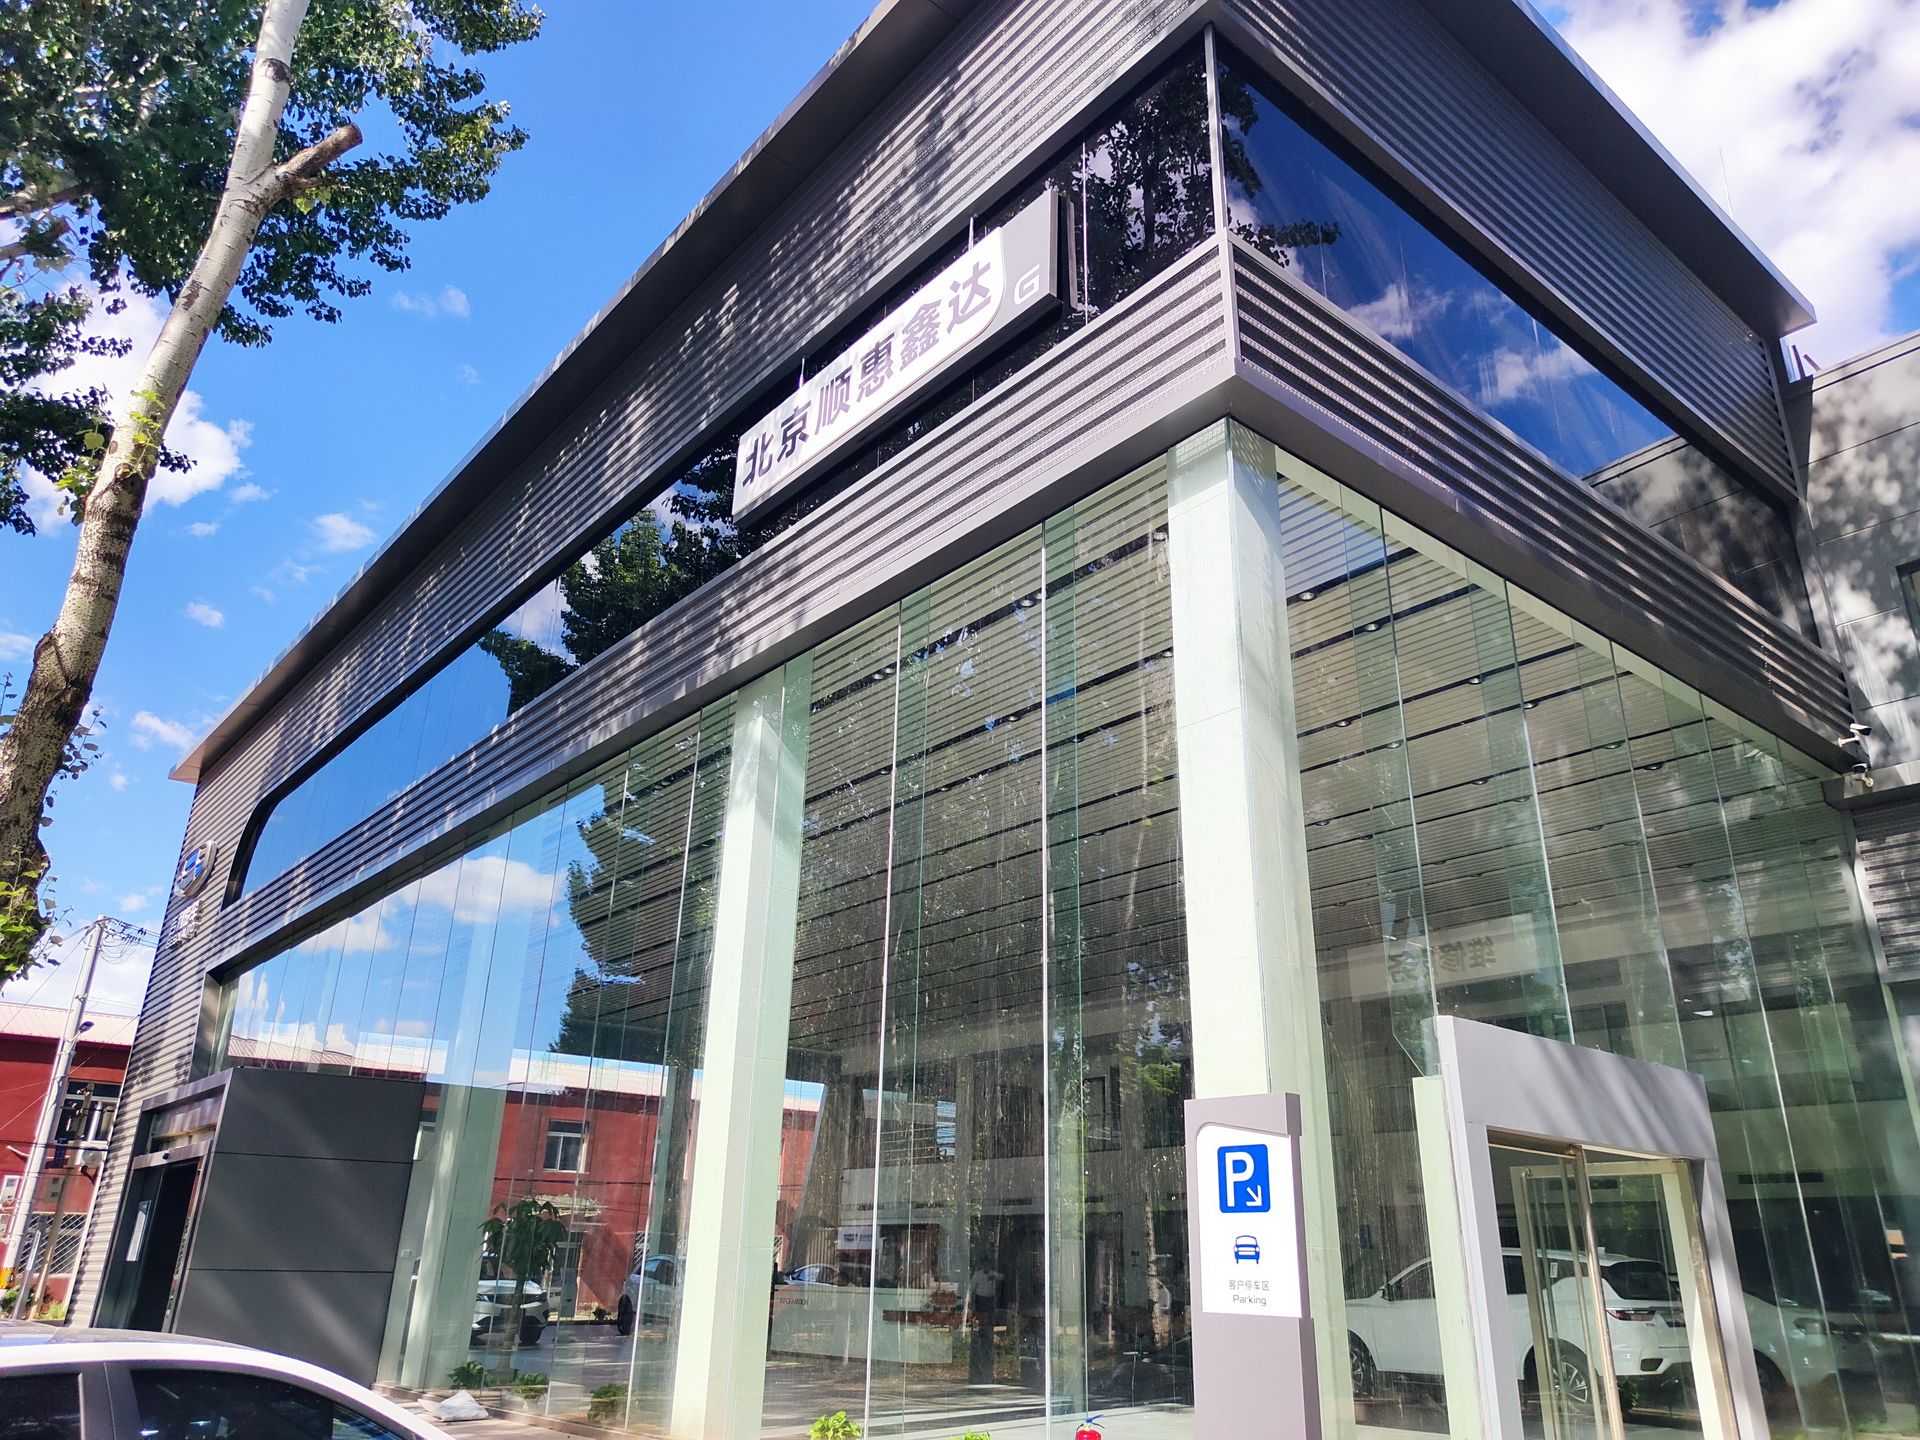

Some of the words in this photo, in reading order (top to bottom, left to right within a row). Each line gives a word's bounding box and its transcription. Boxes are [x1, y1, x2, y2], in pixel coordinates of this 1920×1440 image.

[742, 261, 992, 488] 北京顺惠鑫达
[1224, 1151, 1255, 1207] P
[1229, 1280, 1270, 1291] 客户停车区
[1232, 1294, 1267, 1307] Parking
